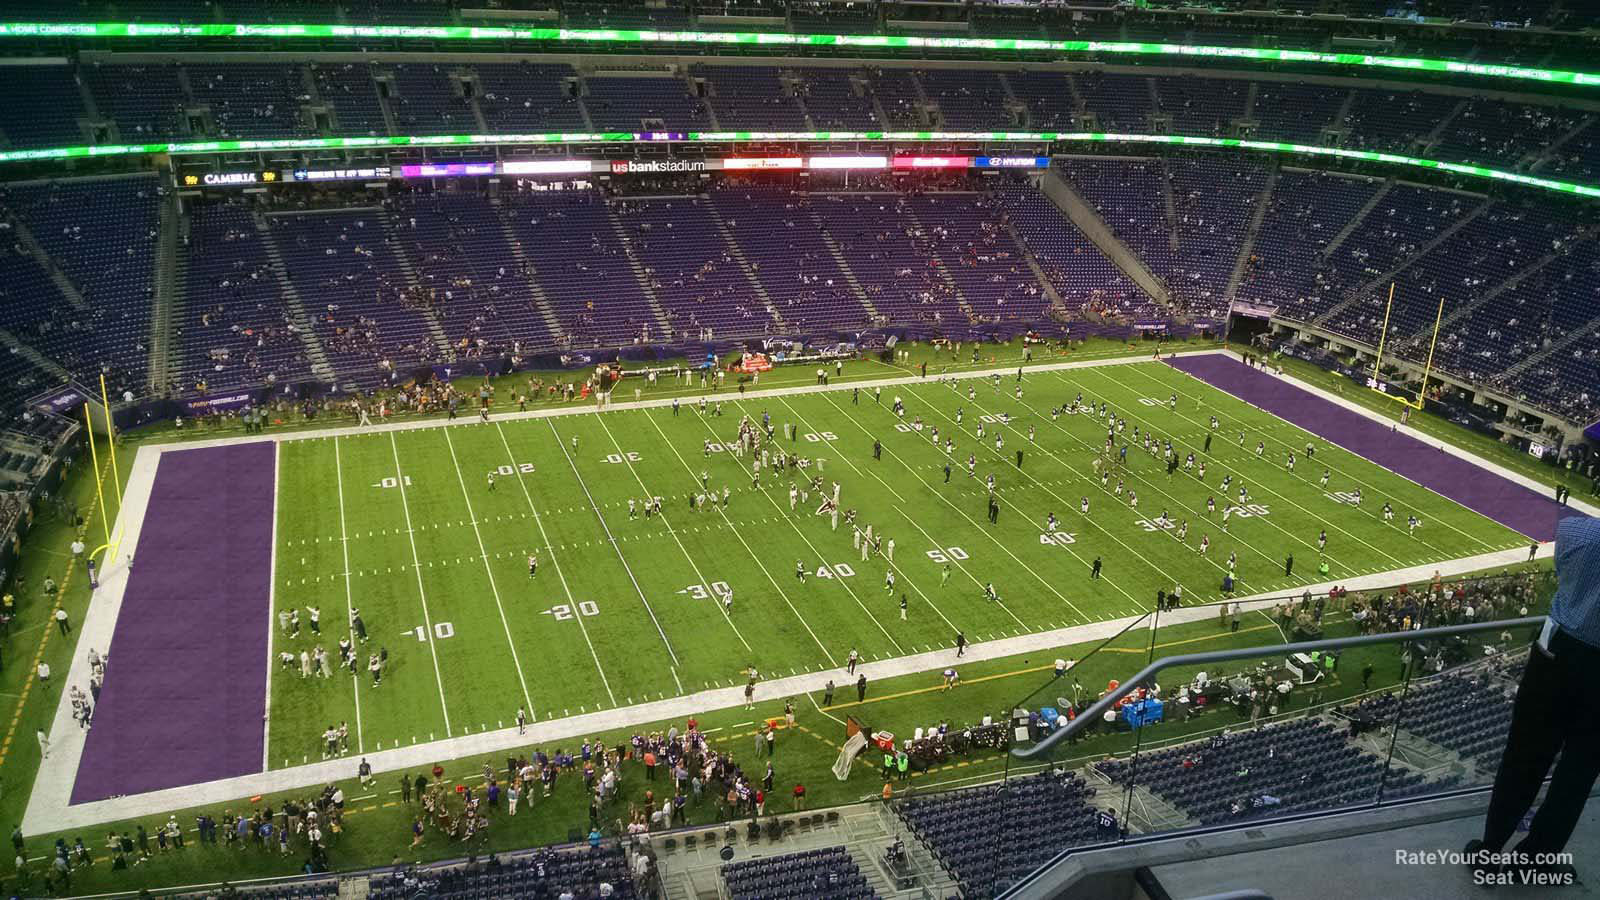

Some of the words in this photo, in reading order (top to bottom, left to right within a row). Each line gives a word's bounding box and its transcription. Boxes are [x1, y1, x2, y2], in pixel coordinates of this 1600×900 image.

[1003, 158, 1036, 166] HYUNDAI
[204, 173, 256, 184] CAMBRIA
[804, 431, 839, 442] 50
[606, 452, 643, 464] 30
[498, 463, 535, 475] 20
[381, 475, 412, 489] 10
[1040, 532, 1077, 546] 40
[926, 547, 970, 563] 50
[816, 563, 856, 579] 40
[686, 581, 731, 600] 30
[552, 600, 600, 621] 20
[416, 622, 455, 642] 10
